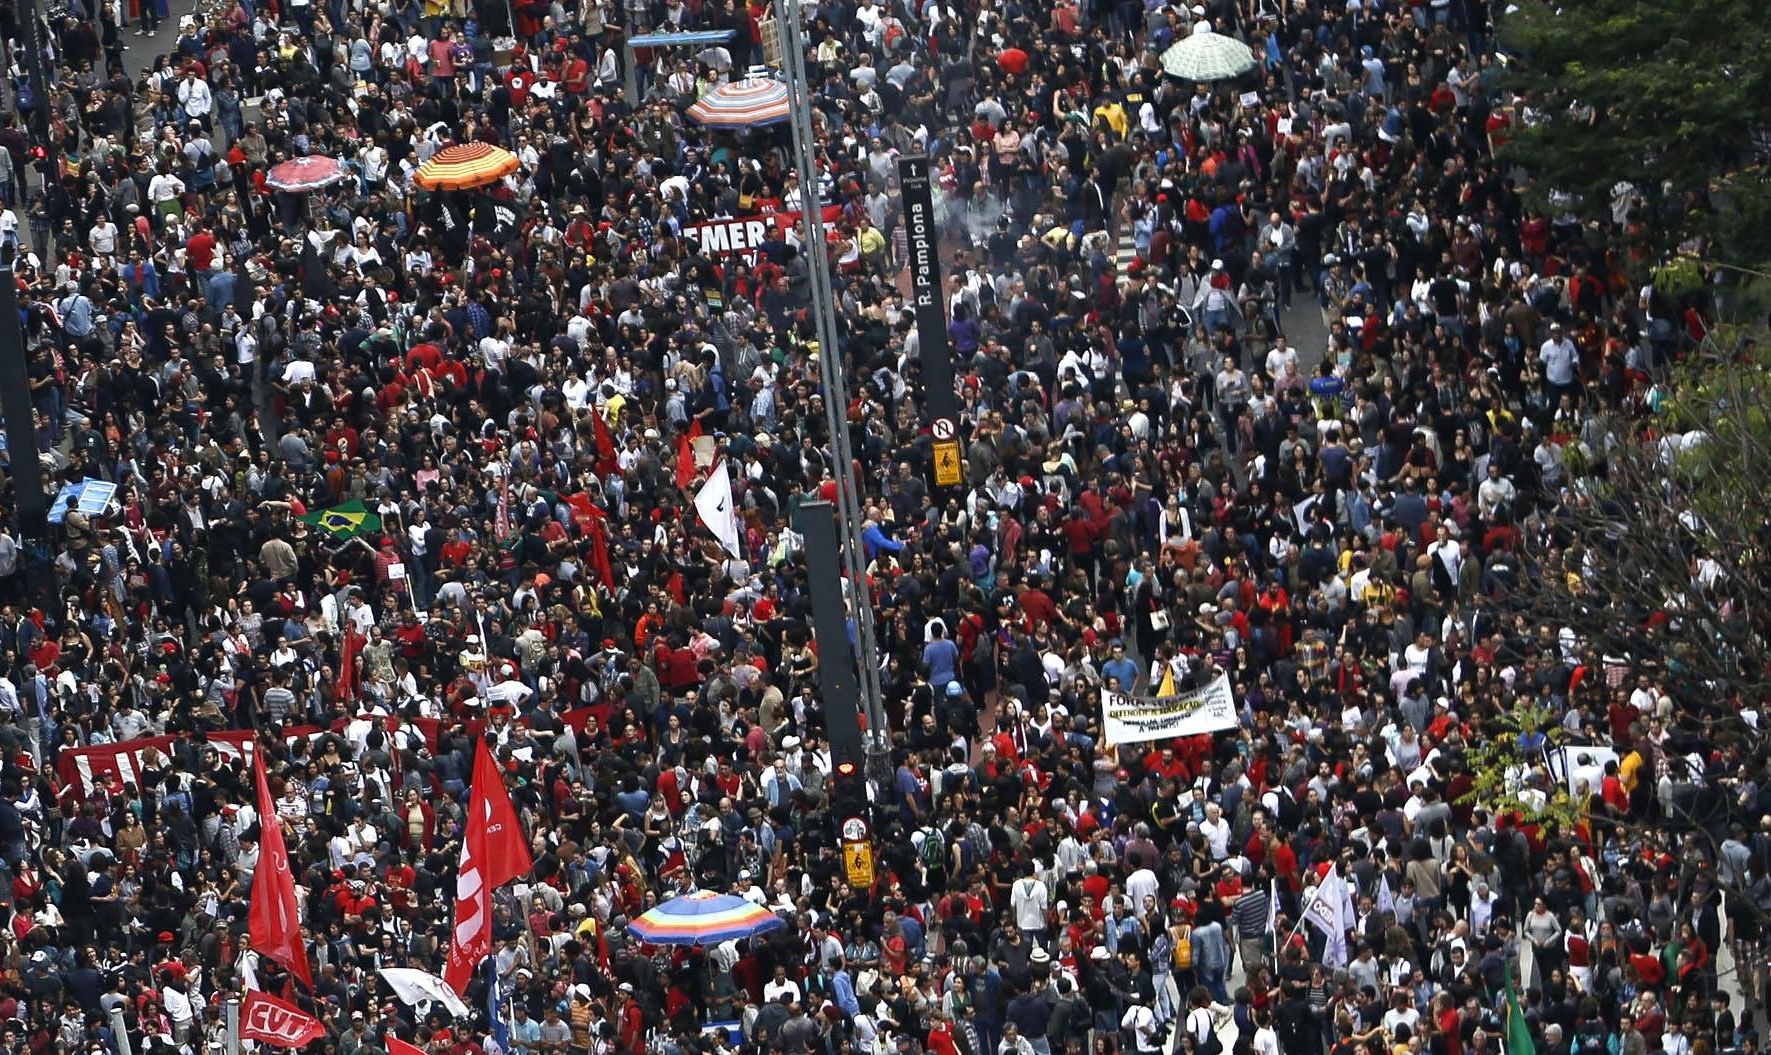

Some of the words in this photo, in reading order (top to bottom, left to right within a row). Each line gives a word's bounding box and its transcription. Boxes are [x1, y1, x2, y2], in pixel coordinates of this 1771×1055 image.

[682, 217, 776, 253] EMER
[911, 203, 931, 286] Pamplona
[918, 292, 932, 307] R.
[251, 1004, 307, 1036] CUT
